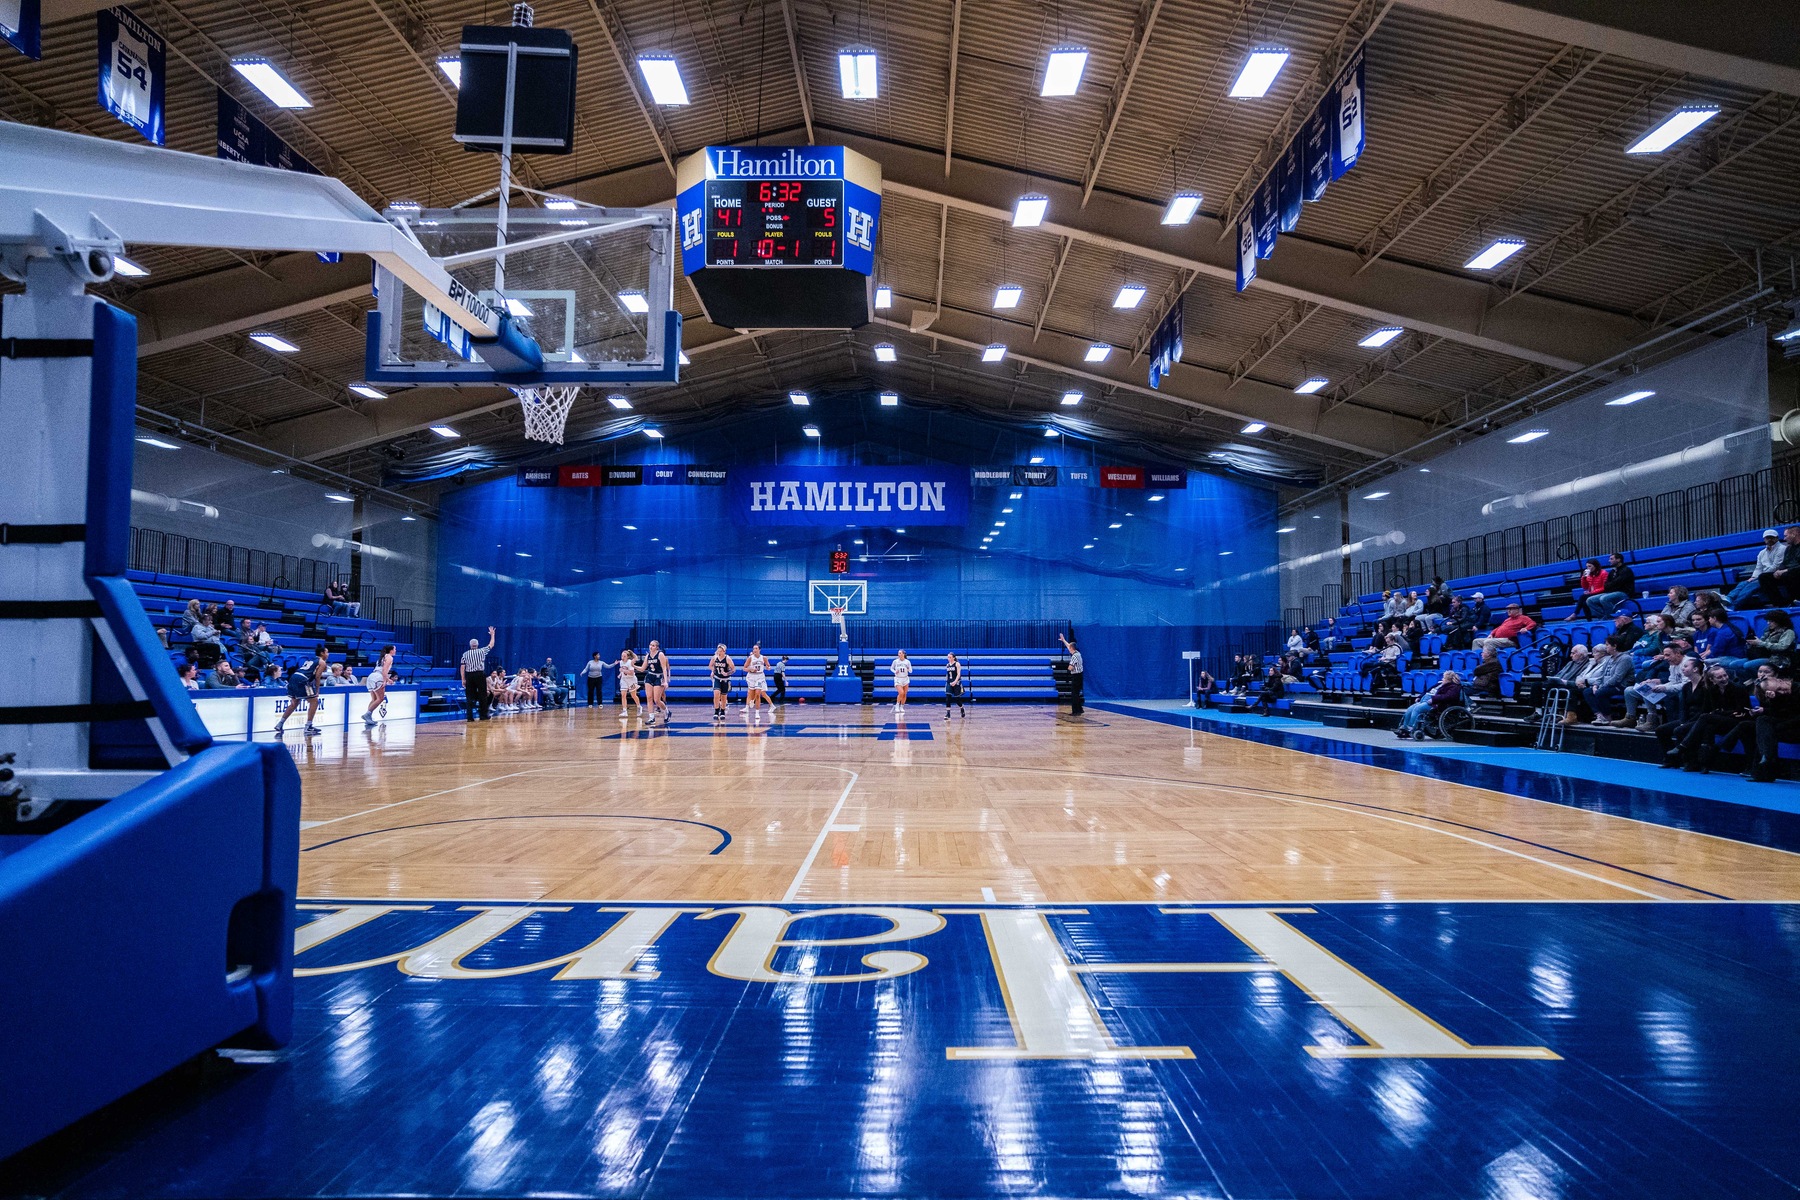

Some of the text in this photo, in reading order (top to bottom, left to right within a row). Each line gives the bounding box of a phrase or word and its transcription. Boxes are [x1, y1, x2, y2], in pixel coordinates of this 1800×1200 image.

[117, 49, 147, 91] 54
[715, 148, 837, 177] Hamilton
[759, 182, 802, 201] 6:32
[714, 198, 742, 208] HOME
[806, 198, 837, 208] GUEST
[718, 209, 742, 227] 41
[824, 208, 835, 227] 5
[682, 207, 702, 249] H
[847, 206, 873, 250] H
[733, 240, 738, 257] 1
[831, 240, 836, 257] 1
[448, 278, 490, 324] BPI 10000
[571, 472, 589, 480] BATES
[655, 470, 674, 478] COLBY
[687, 470, 727, 478] CONNECTICUT
[974, 471, 1011, 479] MIDDLEBURY
[1024, 471, 1047, 479] TRINITY
[1070, 472, 1088, 480] TUFTS
[1107, 473, 1137, 481] WESLEYAN
[1151, 474, 1180, 482] WILLIAMS
[750, 481, 946, 511] HAMILTON
[833, 560, 847, 572] 30
[838, 665, 848, 676] H
